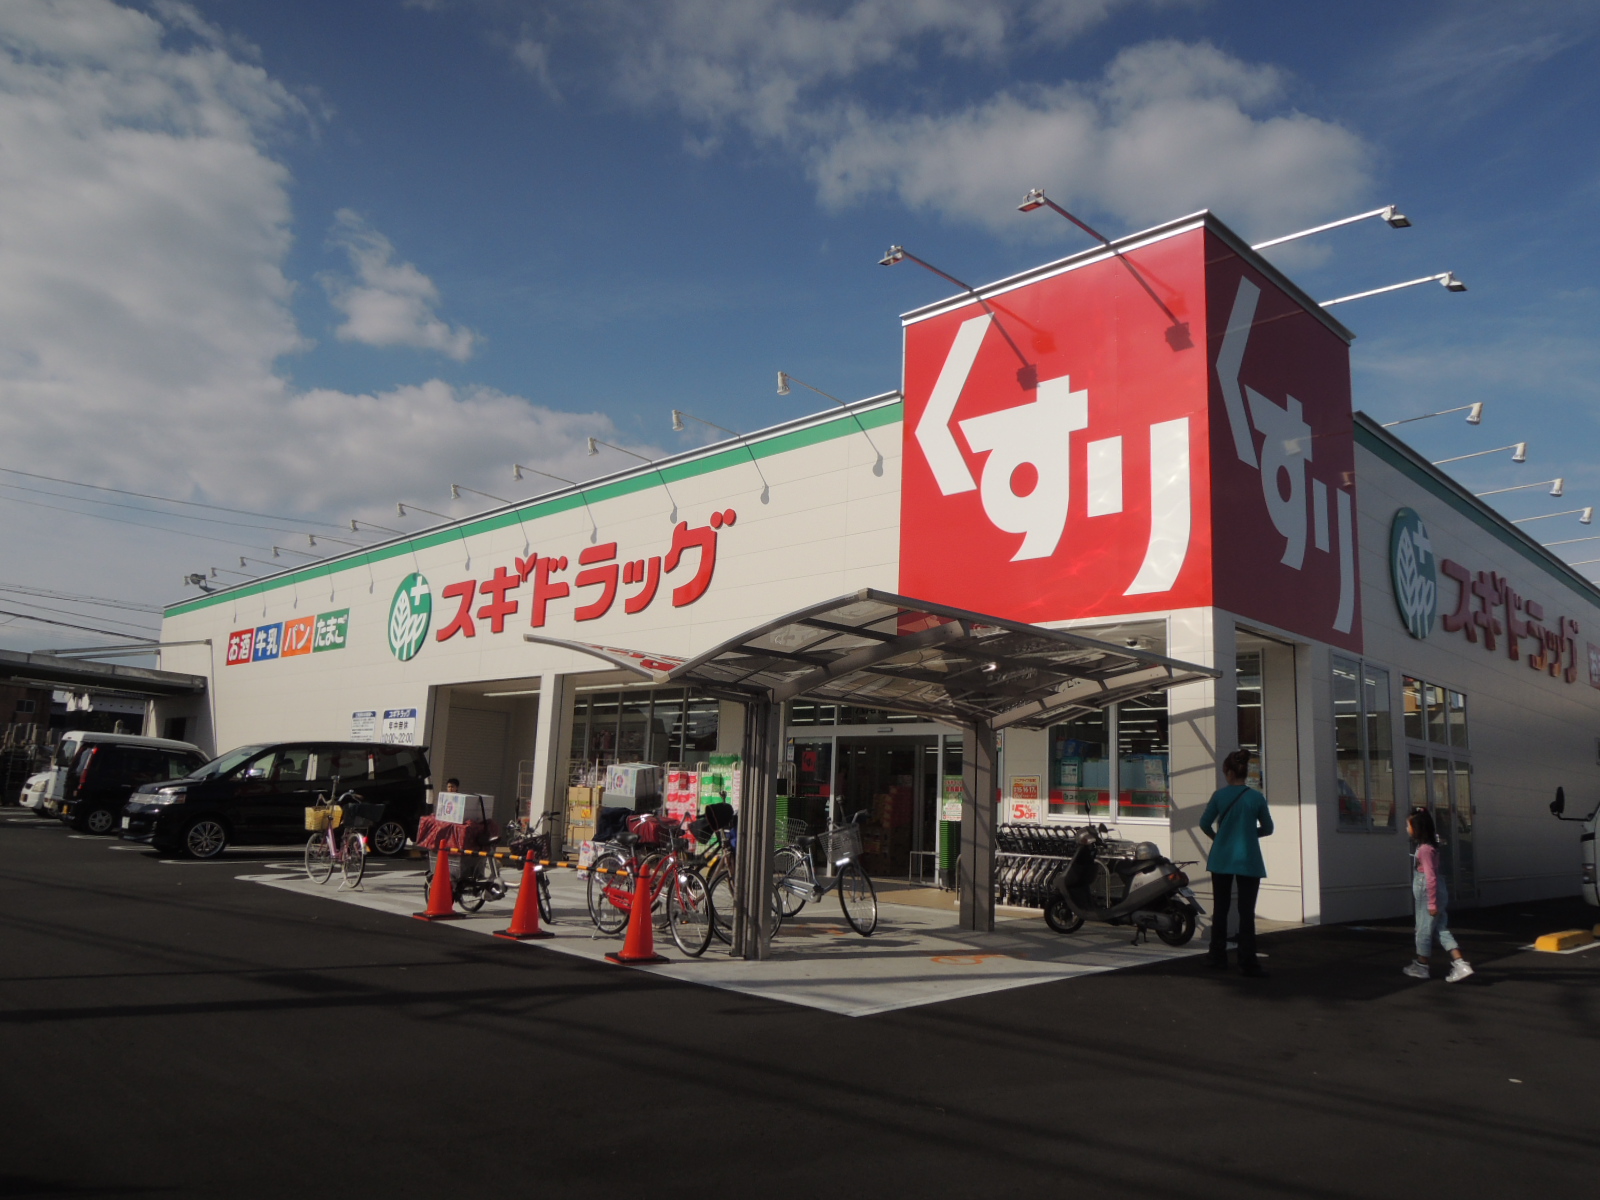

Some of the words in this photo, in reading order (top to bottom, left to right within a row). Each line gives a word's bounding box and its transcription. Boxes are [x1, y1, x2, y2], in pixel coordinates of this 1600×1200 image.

[914, 311, 1192, 596] くすり
[1215, 275, 1355, 634] くすり
[436, 508, 737, 642] スギドラッグ
[228, 633, 252, 661] お酒
[255, 629, 278, 657] 牛乳
[283, 624, 311, 651] パン
[315, 615, 348, 647] たまご
[1442, 559, 1579, 683] スギドラッグ
